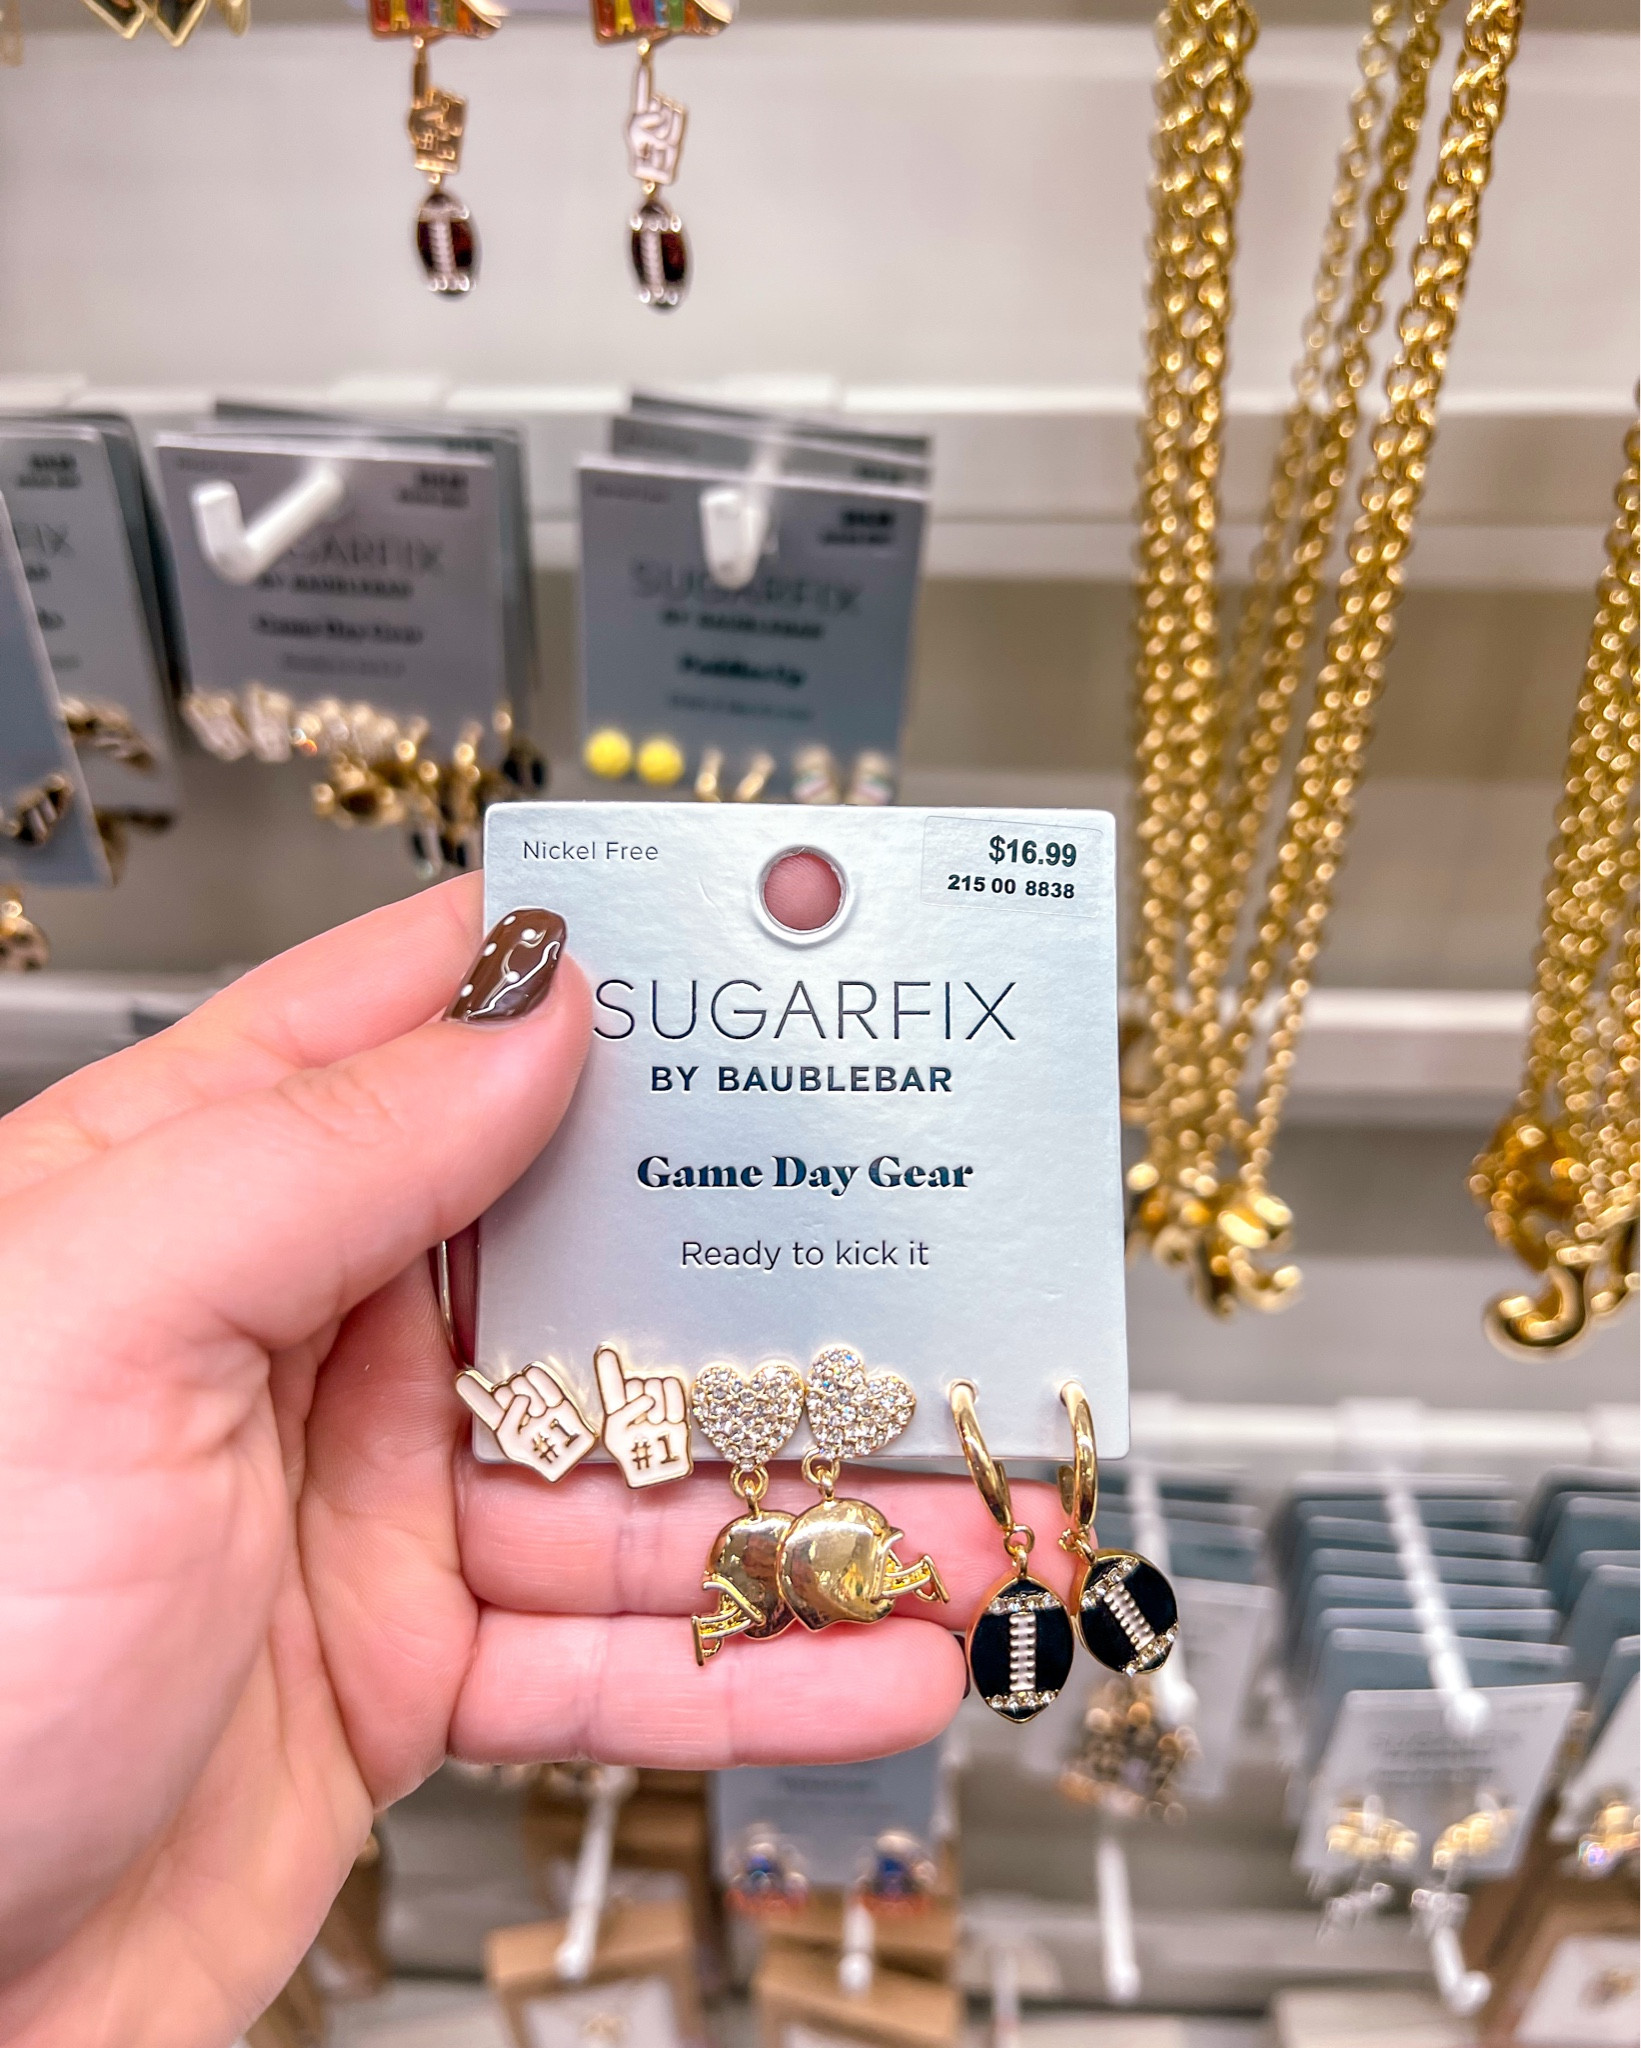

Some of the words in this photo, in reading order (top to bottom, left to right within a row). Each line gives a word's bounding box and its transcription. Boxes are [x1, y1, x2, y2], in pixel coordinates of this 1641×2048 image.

[522, 840, 596, 861] Nickel
[606, 841, 660, 862] Free
[988, 834, 1077, 868] $16.99
[946, 873, 986, 893] 215
[990, 877, 1017, 896] 00
[1024, 879, 1076, 900] 8838
[592, 979, 1017, 1041] SUGARFIX
[651, 1065, 700, 1092] BY
[718, 1065, 953, 1093] BAUBLEBAR
[636, 1155, 764, 1189] Game
[771, 1155, 861, 1197] Day
[867, 1155, 974, 1189] Gear
[682, 1239, 782, 1271] Ready
[792, 1241, 824, 1267] to
[836, 1239, 899, 1266] kick
[909, 1239, 930, 1266] it
[532, 1417, 583, 1465] #1
[631, 1433, 681, 1471] #1
